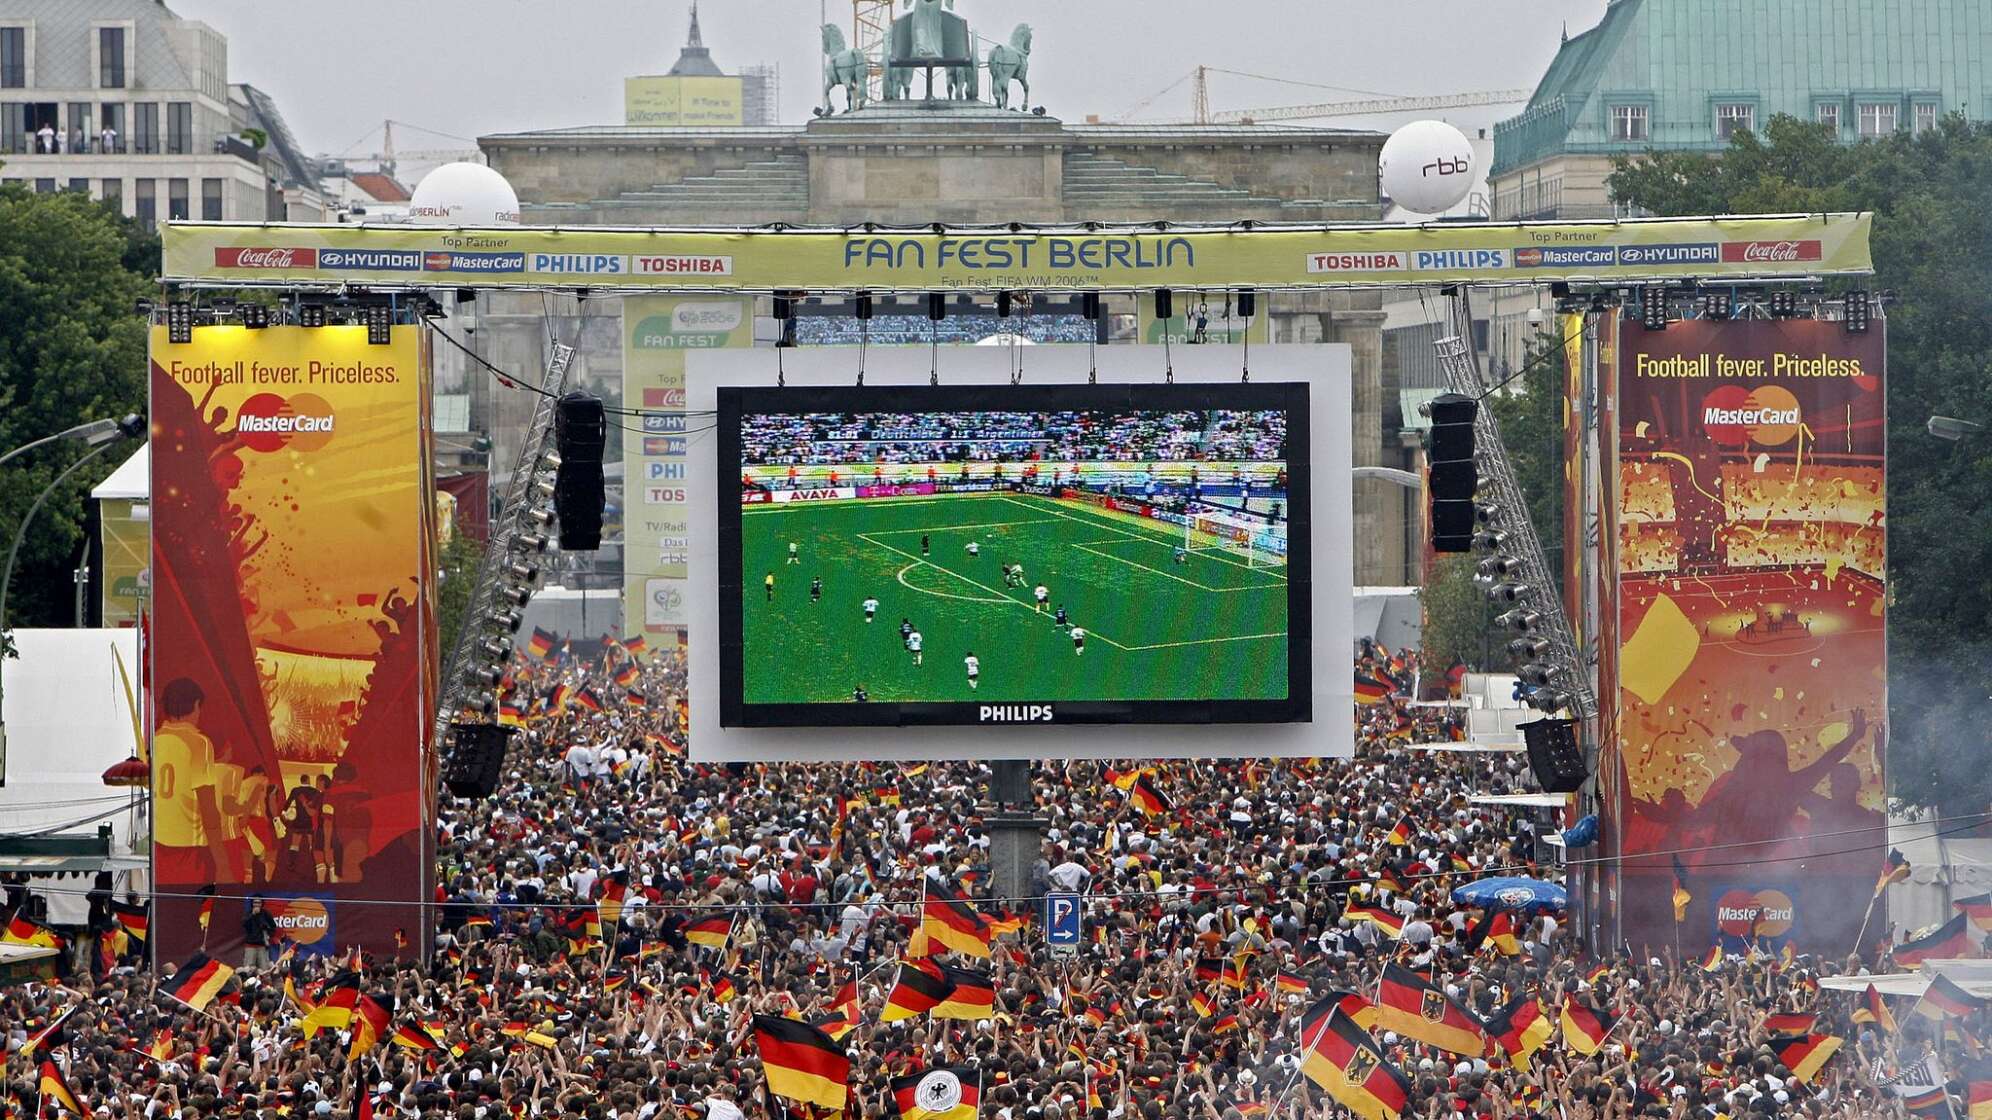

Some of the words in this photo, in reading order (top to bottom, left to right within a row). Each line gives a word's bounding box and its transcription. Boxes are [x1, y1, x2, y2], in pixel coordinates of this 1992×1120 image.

[1422, 156, 1468, 177] rbb
[441, 236, 462, 248] Top
[466, 237, 509, 248] Partner
[1530, 231, 1551, 243] Top
[1554, 231, 1598, 241] Partner
[345, 254, 419, 267] HYUNDAI
[844, 238, 925, 269] FAN
[937, 239, 1037, 269] FEST
[1049, 237, 1195, 268] BERLIN
[1418, 250, 1504, 269] PHILIPS
[1543, 250, 1614, 263] MasterCard
[1644, 246, 1717, 261] HYUNDAI
[452, 256, 523, 269] MasterCard
[535, 254, 620, 273] PHILIPS
[640, 258, 725, 273] TOSHIBA
[1314, 254, 1400, 269] TOSHIBA
[941, 276, 963, 286] Fan
[967, 275, 992, 286] Fest
[996, 275, 1023, 286] FIFA
[1027, 275, 1050, 286] WM
[643, 335, 674, 347] FAN
[678, 335, 717, 347] FEST
[171, 360, 244, 385] Football
[251, 361, 302, 385] fever.
[309, 361, 400, 385] Priceless.
[1636, 353, 1710, 378] Football
[1716, 353, 1768, 378] fever.
[1773, 353, 1865, 378] Priceless.
[658, 374, 677, 386] Top
[238, 414, 334, 433] MasterCard
[1703, 407, 1799, 425] MasterCard
[790, 488, 839, 500] AVAYA
[646, 521, 688, 532] TV/Radi
[980, 704, 1054, 721] PHILIPS
[1718, 906, 1793, 921] MasteCard
[272, 914, 328, 929] sterCard
